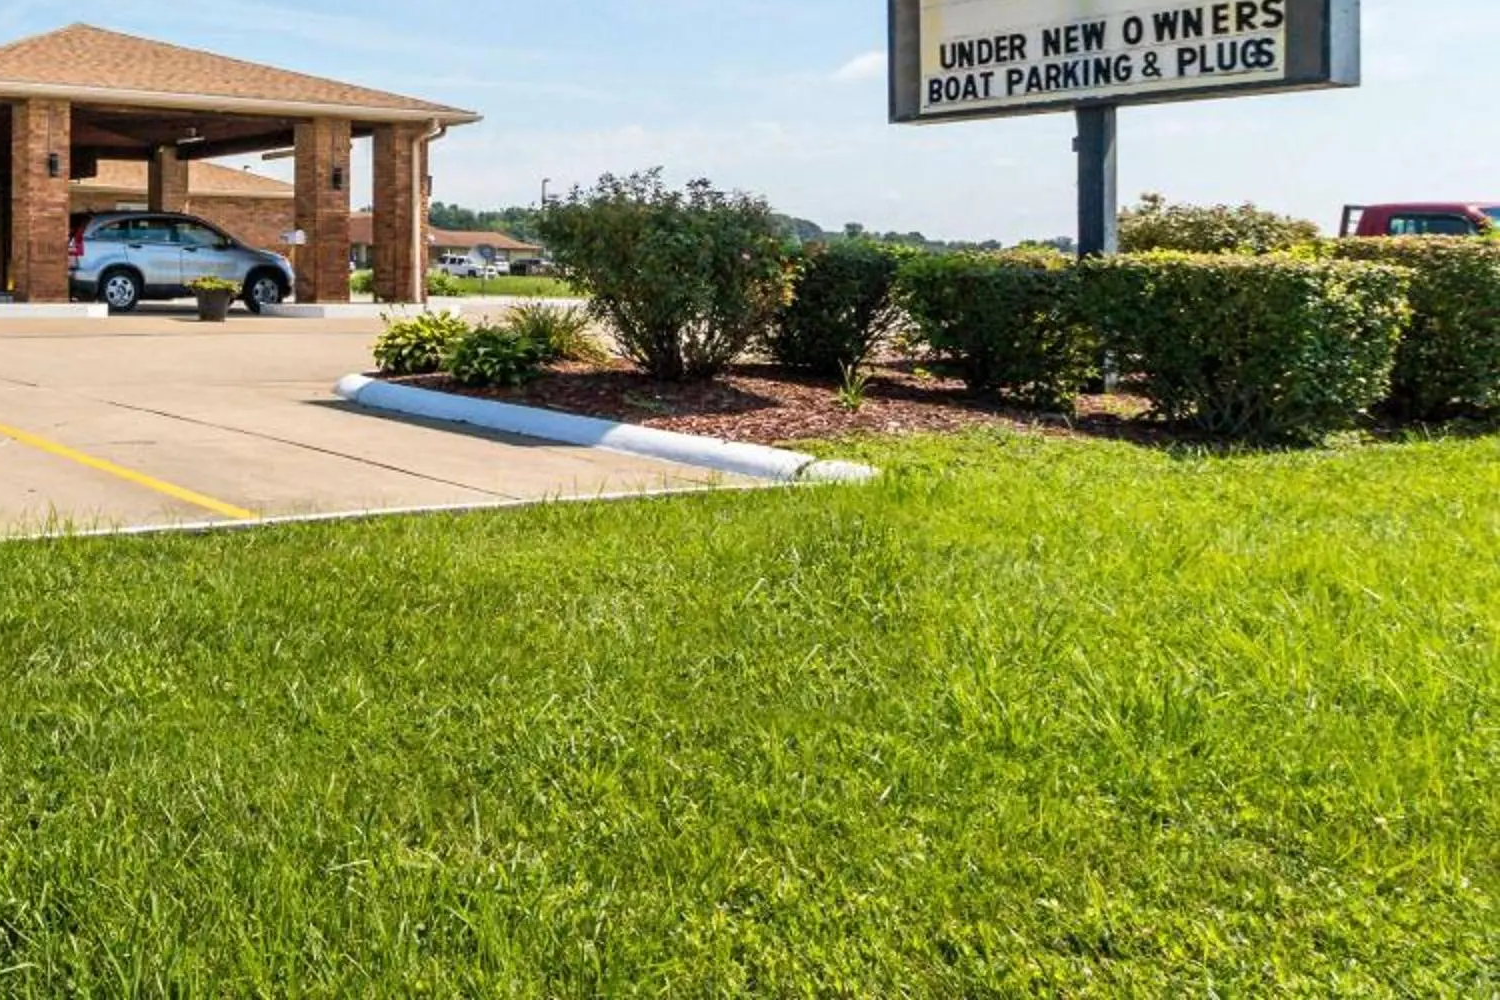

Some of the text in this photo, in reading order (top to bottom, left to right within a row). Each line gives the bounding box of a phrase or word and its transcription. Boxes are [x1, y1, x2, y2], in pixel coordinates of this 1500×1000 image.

[940, 34, 1026, 69] UNDER
[1043, 22, 1107, 55] NEW
[929, 74, 995, 105] BOAT
[1006, 53, 1132, 96] PARKING
[1142, 51, 1161, 77] &
